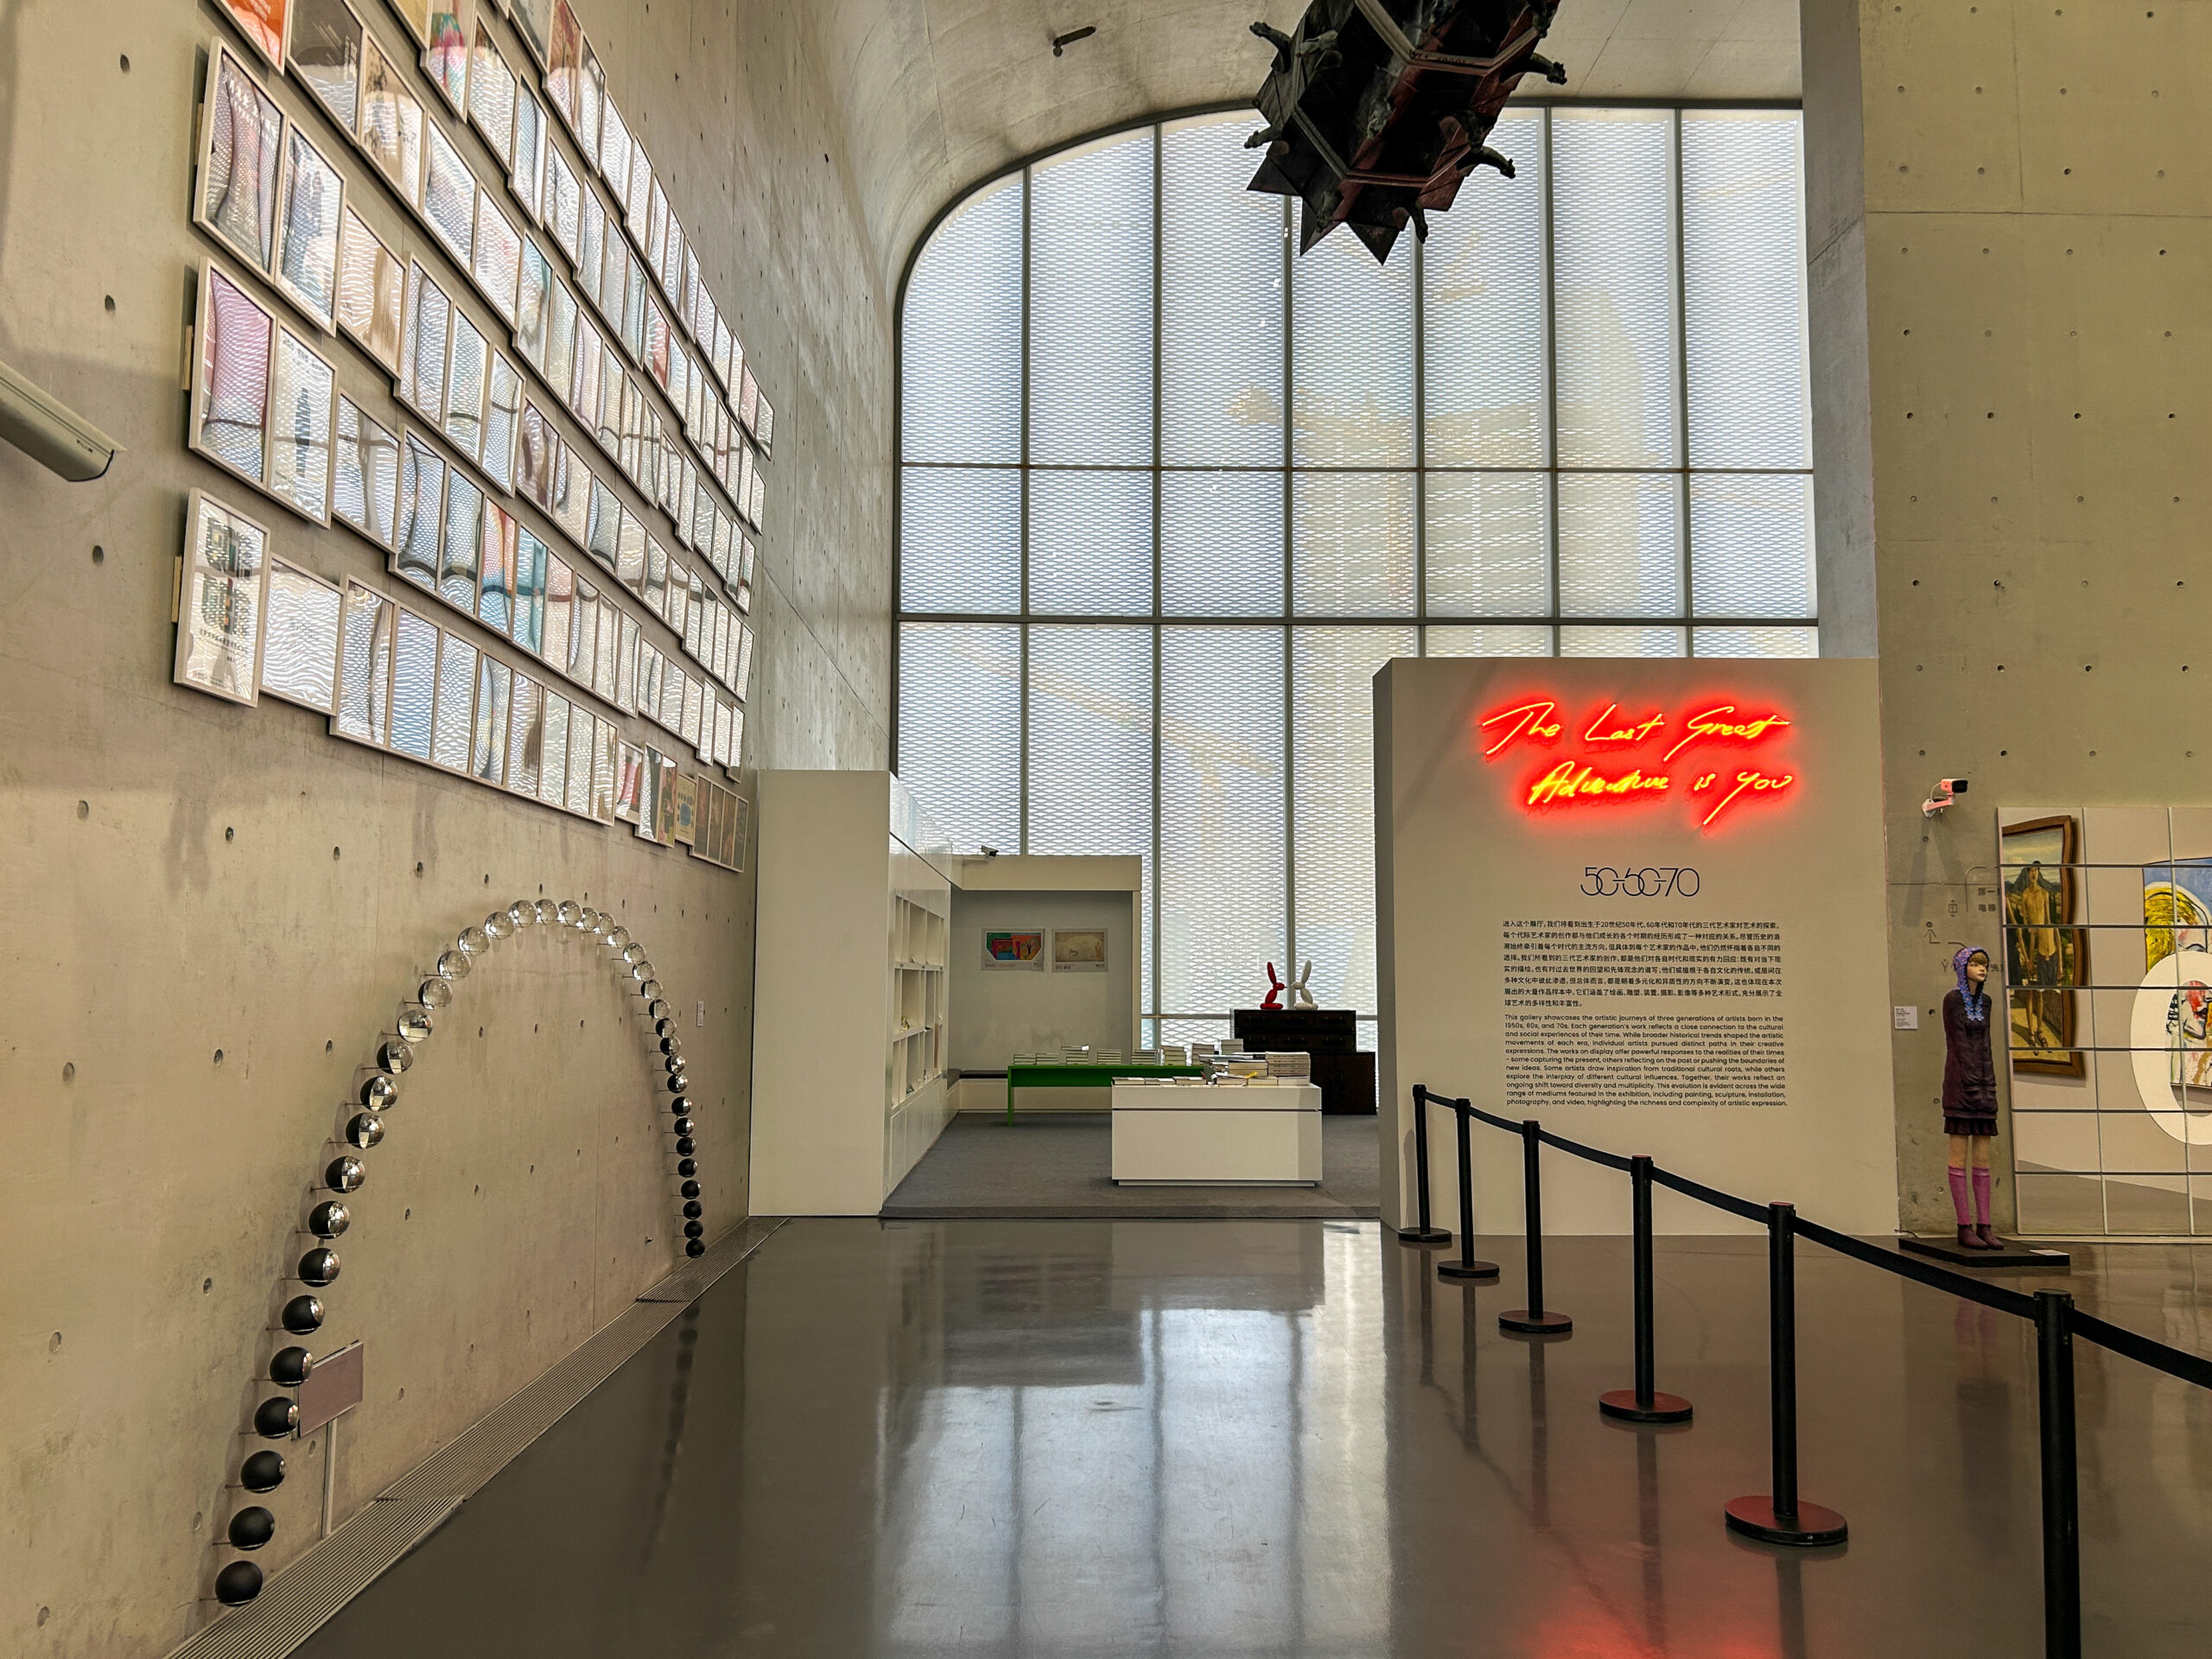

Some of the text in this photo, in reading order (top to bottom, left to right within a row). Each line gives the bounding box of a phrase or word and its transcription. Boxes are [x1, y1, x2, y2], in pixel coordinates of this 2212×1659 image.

[1481, 701, 1791, 762] The Last Great
[1528, 760, 1669, 804] Adventure
